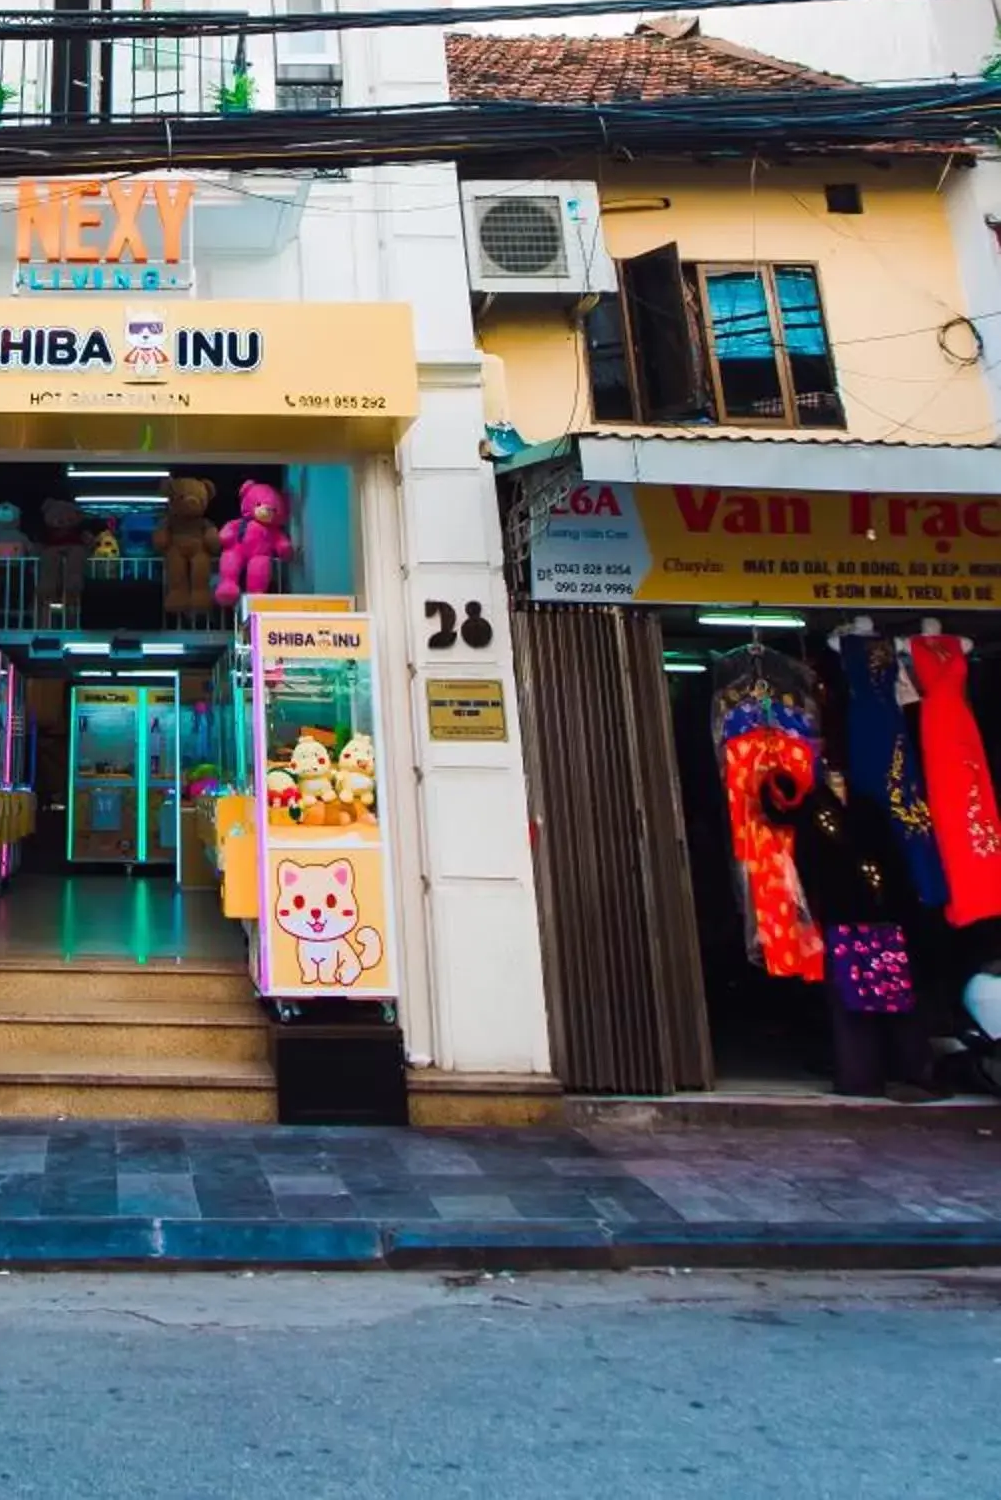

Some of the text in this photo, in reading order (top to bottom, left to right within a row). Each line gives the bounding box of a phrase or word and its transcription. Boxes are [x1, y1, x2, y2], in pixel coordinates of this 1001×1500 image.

[17, 179, 196, 264] NEXY
[29, 267, 161, 292] LIVING
[176, 329, 261, 370] INU
[267, 632, 361, 648] SHIBA INU
[424, 600, 494, 649] 28
